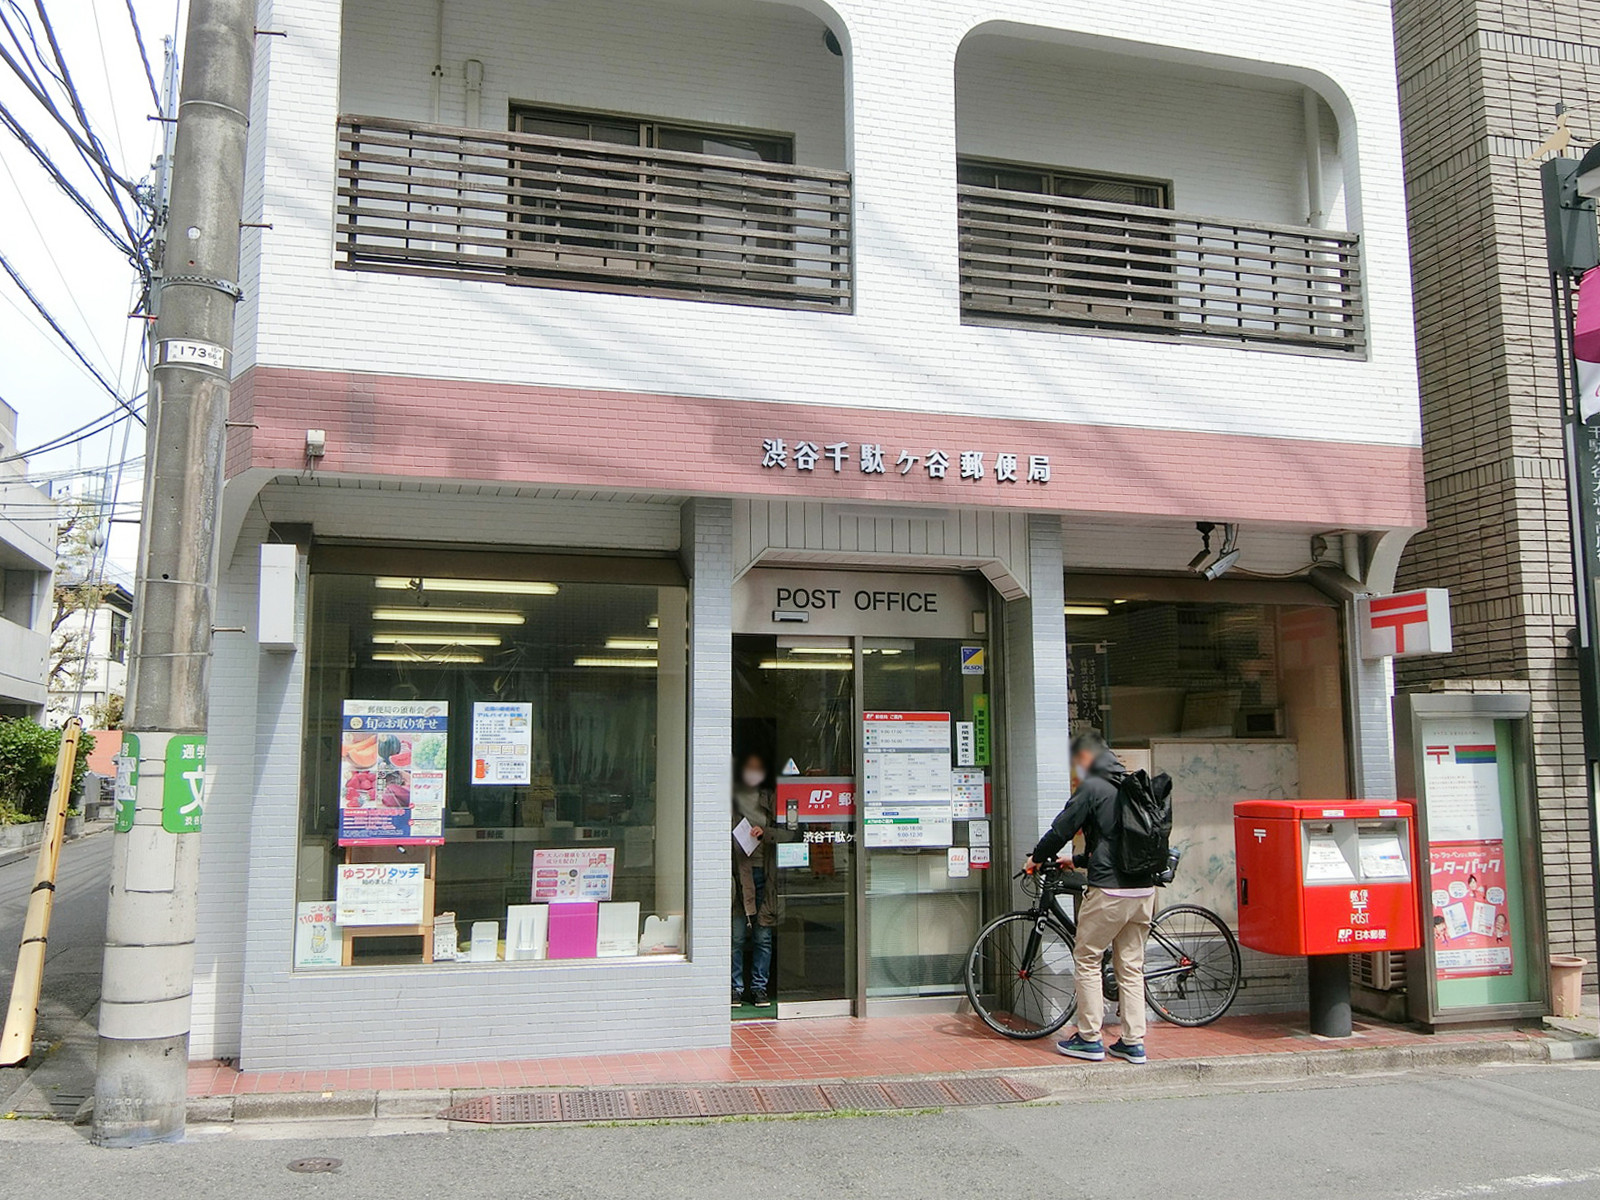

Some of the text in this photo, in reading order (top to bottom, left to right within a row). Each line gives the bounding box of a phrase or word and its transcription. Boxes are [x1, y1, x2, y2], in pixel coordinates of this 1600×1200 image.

[181, 346, 207, 358] 173
[777, 588, 937, 613] POST OFFICE
[365, 717, 439, 730] 旬のお取り寄せ
[343, 867, 419, 879] ゆうプリタッチ
[1430, 859, 1501, 875] レターパック
[1350, 889, 1369, 903] 郵便
[310, 904, 332, 913] こども
[1350, 913, 1370, 924] POST
[1354, 929, 1387, 940] 日本郵便
